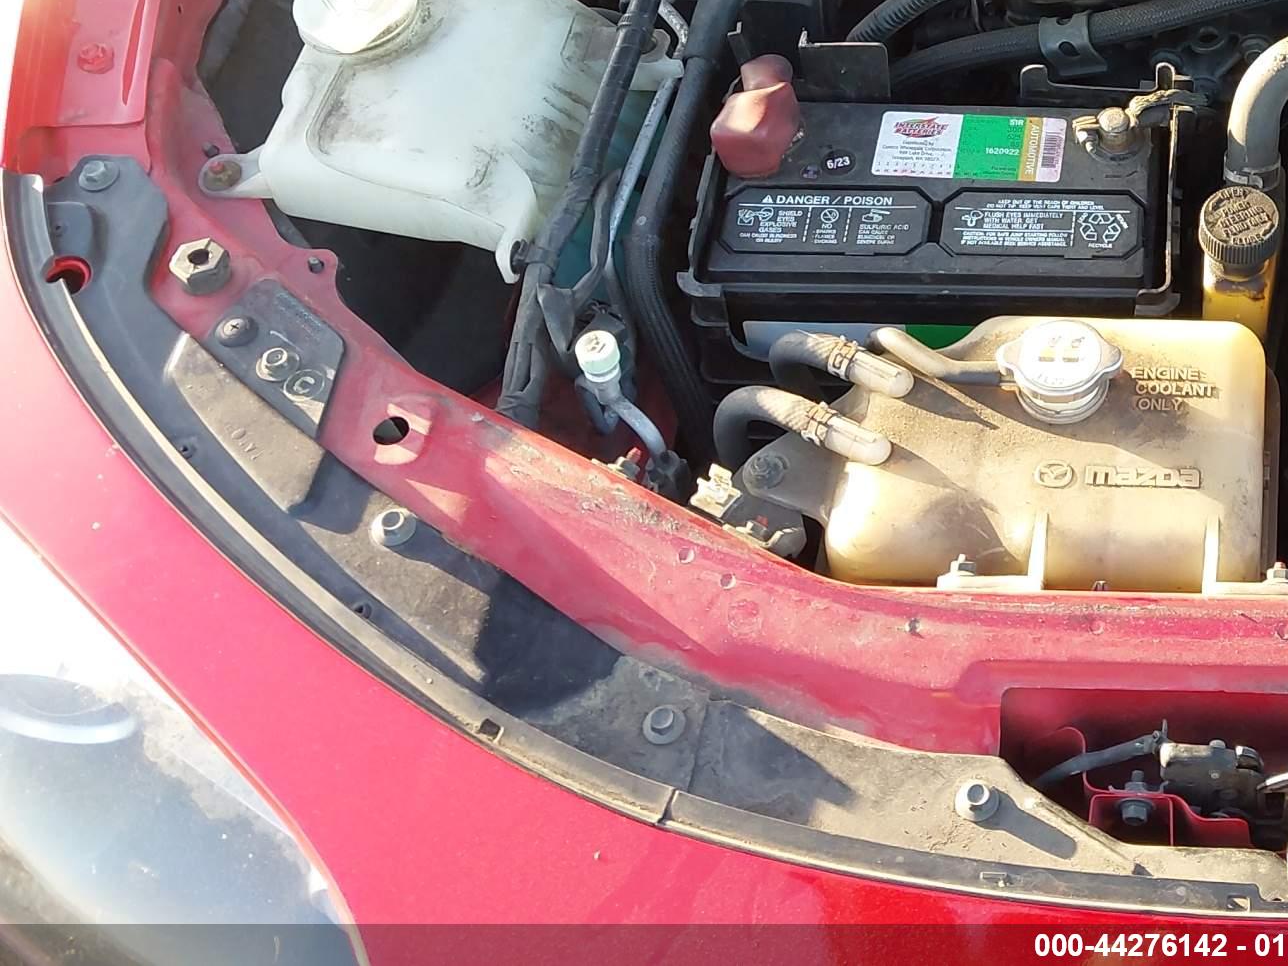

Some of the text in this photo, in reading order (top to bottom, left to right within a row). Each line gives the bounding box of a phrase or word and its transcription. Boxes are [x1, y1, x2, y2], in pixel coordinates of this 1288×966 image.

[985, 147, 1020, 155] 1620922
[1025, 124, 1040, 175] AUTOMOTIVE
[826, 156, 850, 169] 6/23
[776, 196, 830, 205] DANGER
[843, 196, 893, 206] POISON
[1132, 367, 1201, 381] ENGINE
[1135, 381, 1214, 398] COOLANT
[1138, 398, 1184, 412] ONLY
